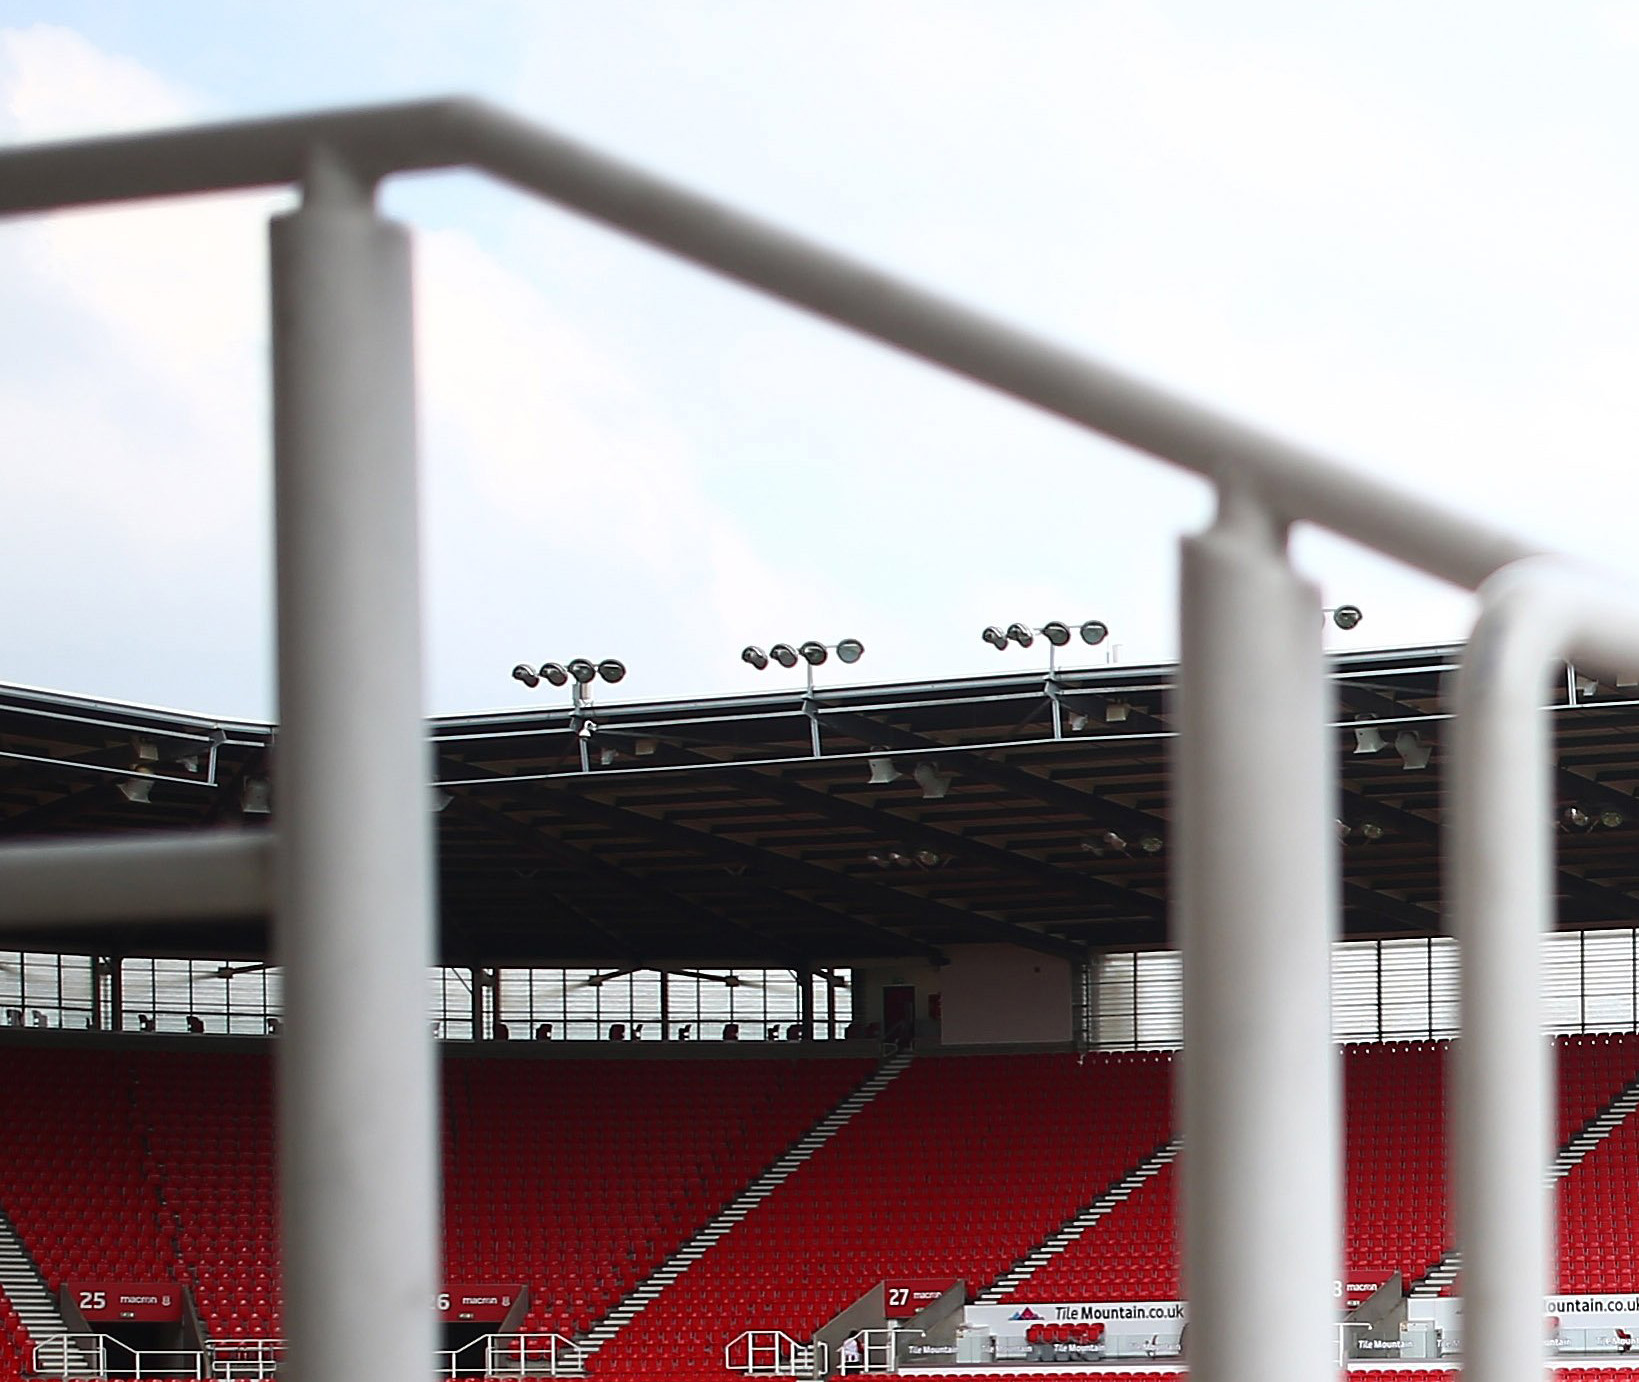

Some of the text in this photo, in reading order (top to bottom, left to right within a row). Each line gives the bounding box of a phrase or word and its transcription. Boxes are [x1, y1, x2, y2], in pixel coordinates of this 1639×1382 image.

[79, 1291, 106, 1309] 25
[429, 1293, 451, 1310] 6
[888, 1288, 910, 1306] 27
[1055, 1304, 1184, 1320] Tile Mountain.co.uk
